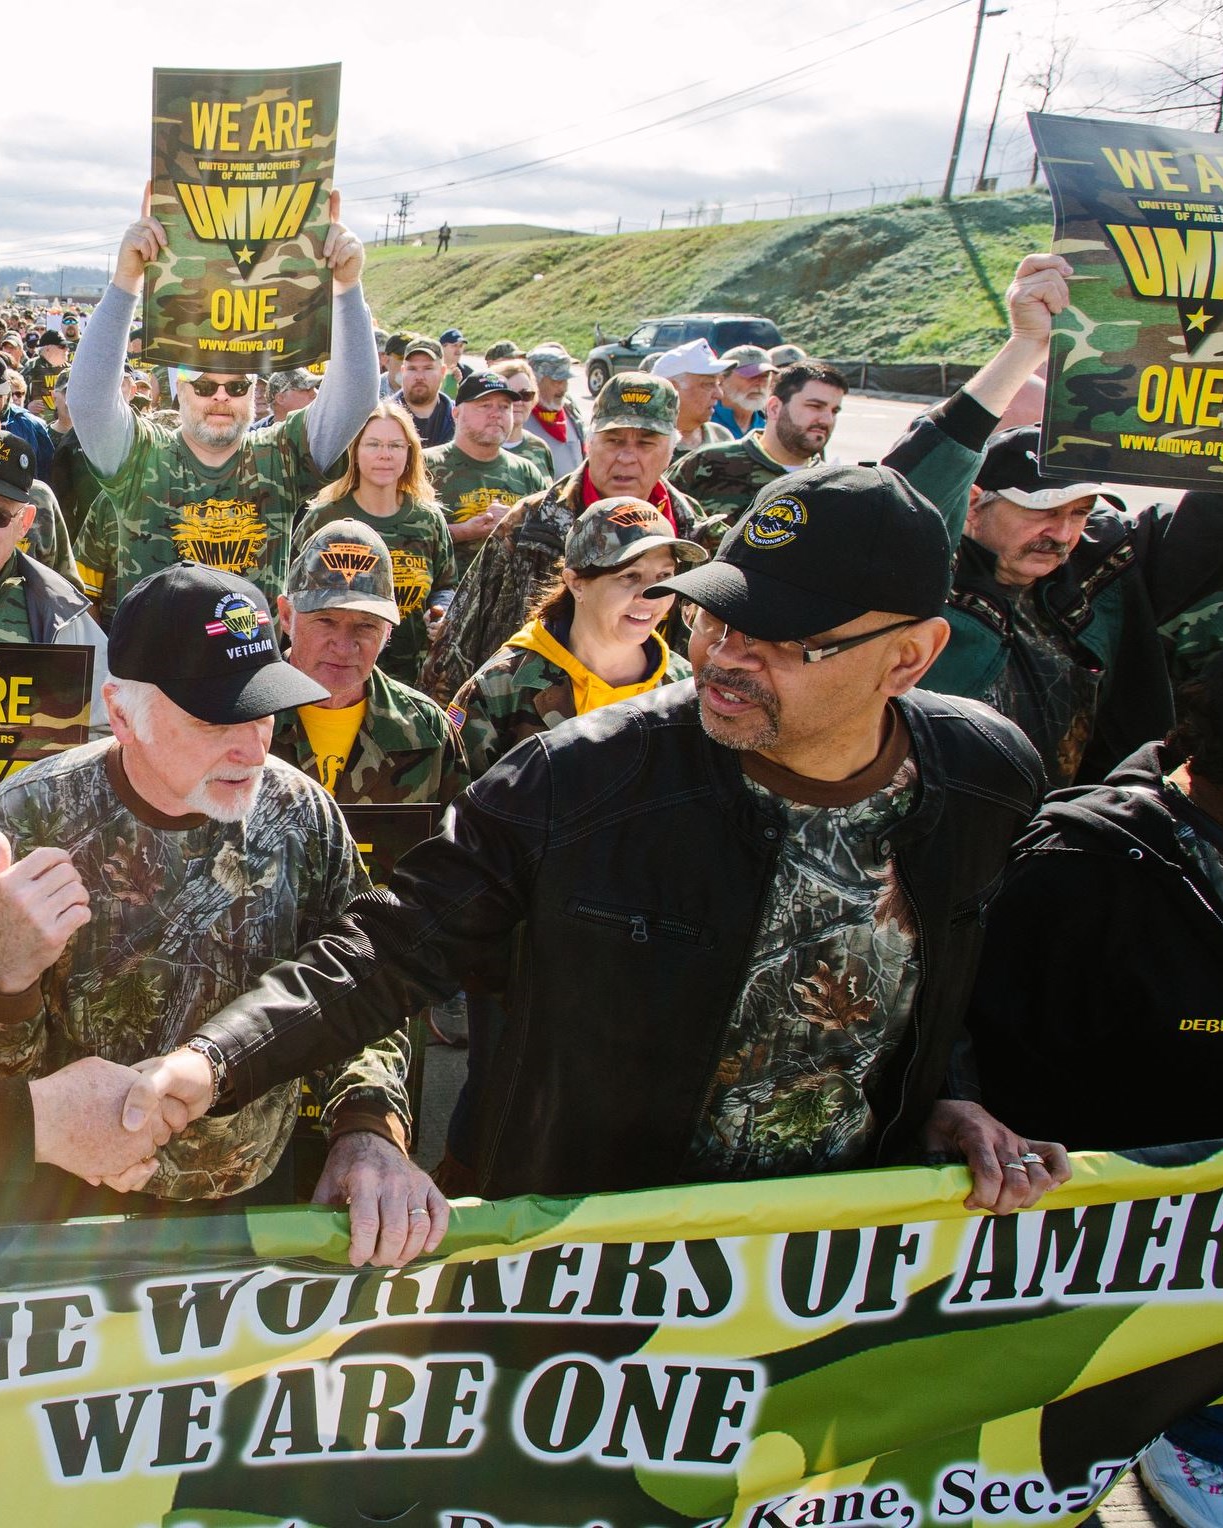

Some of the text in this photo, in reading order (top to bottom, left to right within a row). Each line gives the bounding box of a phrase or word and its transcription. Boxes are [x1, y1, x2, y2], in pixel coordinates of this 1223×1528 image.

[191, 99, 314, 152] WE ARE
[198, 160, 301, 171] UNITED MINE WORKERS
[1101, 147, 1223, 194] WE A
[221, 170, 278, 181] OF AMERICA
[176, 181, 317, 241] UMWA
[1137, 200, 1182, 212] UNITED
[1183, 202, 1214, 213] MINE
[1174, 211, 1223, 224] OF AME
[1104, 224, 1223, 300] UM
[210, 287, 279, 332] ONE
[198, 337, 284, 352] www.umwa.org
[620, 393, 652, 405] UMWA
[1136, 364, 1223, 427] ONE
[459, 494, 476, 503] WE
[183, 503, 258, 520] WE ARE ONE
[610, 510, 659, 527] UMWA
[190, 539, 251, 566] UMWA
[321, 553, 376, 571] UMWA
[405, 557, 428, 569] ONE
[394, 585, 423, 607] WA
[224, 613, 258, 632] UMWA
[226, 639, 274, 660] VETERAN
[1179, 1018, 1223, 1034] DEB
[145, 1238, 733, 1356] WORKERS
[780, 1223, 920, 1318] OF
[948, 1187, 1223, 1305] AMER
[41, 1358, 756, 1478] WE ARE ONE
[748, 1483, 916, 1528] Kane,
